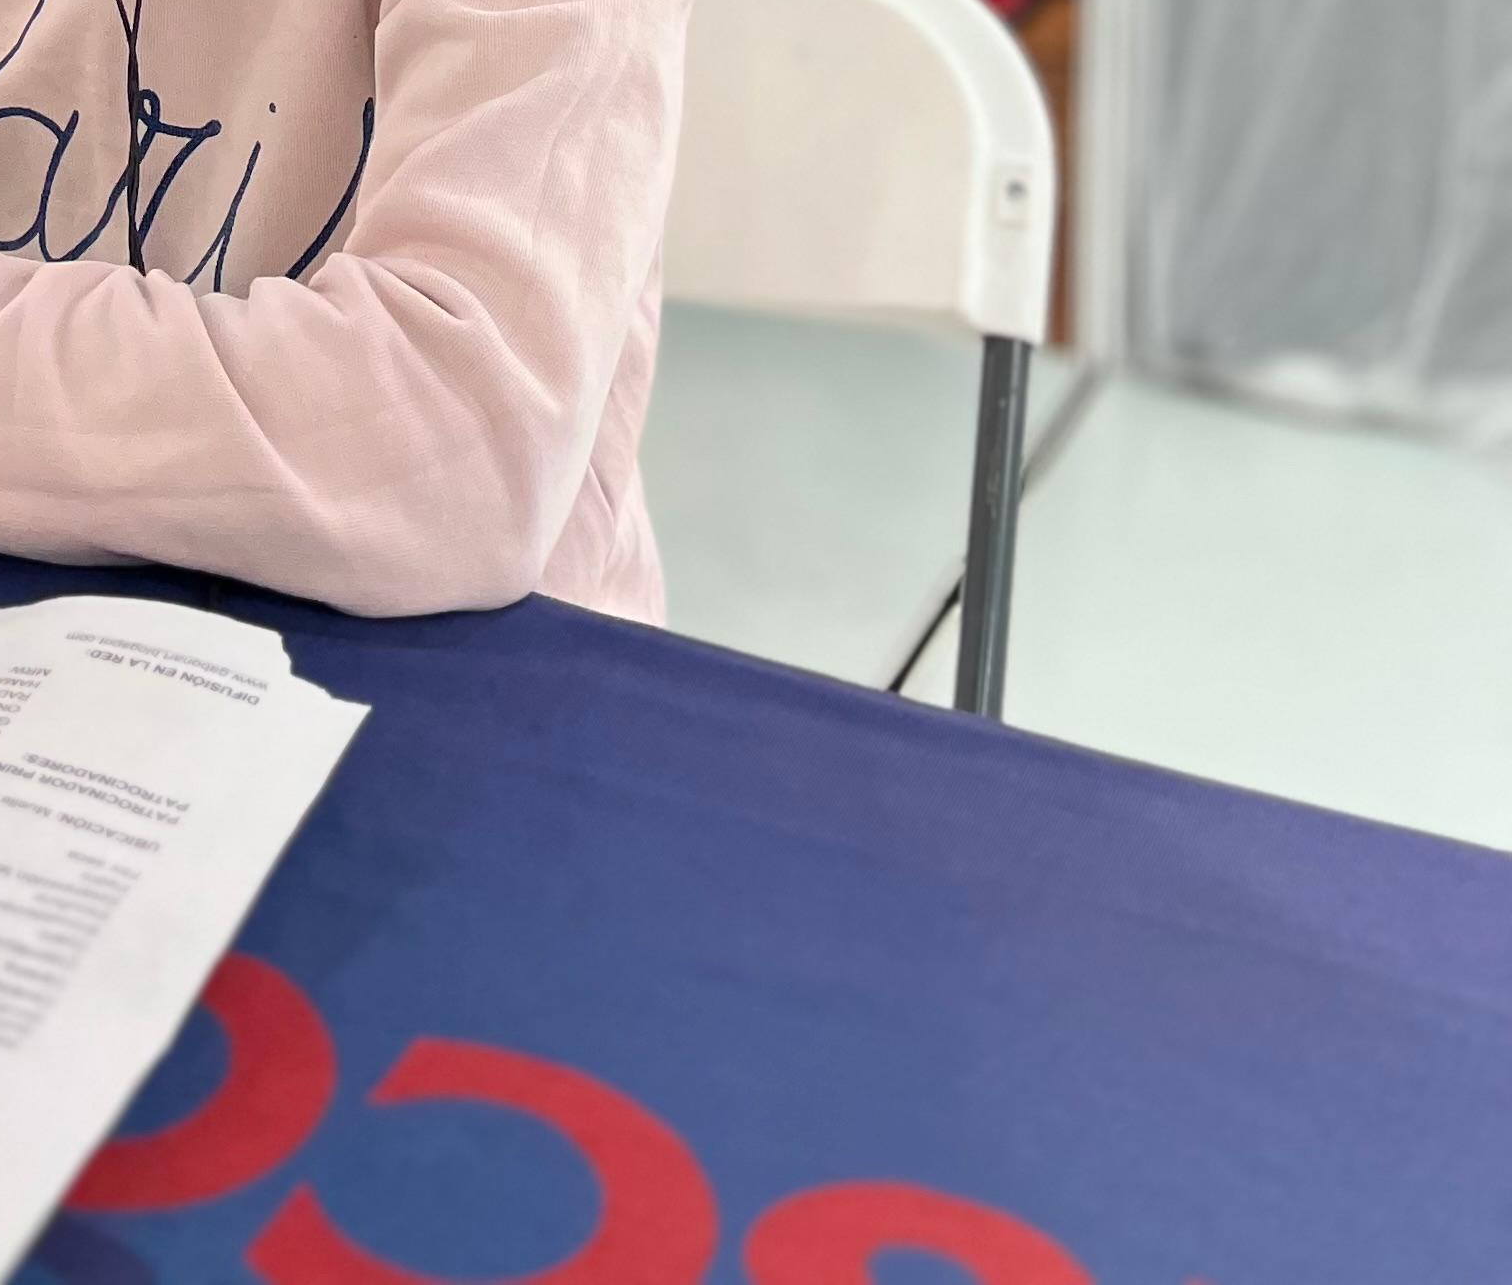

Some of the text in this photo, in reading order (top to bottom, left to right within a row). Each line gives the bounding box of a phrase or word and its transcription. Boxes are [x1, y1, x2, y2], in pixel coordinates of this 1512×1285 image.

[129, 657, 150, 671] LA
[153, 664, 178, 679] EN
[180, 671, 261, 706] DIFUSIÓN
[38, 773, 182, 825] PATROCINADOR
